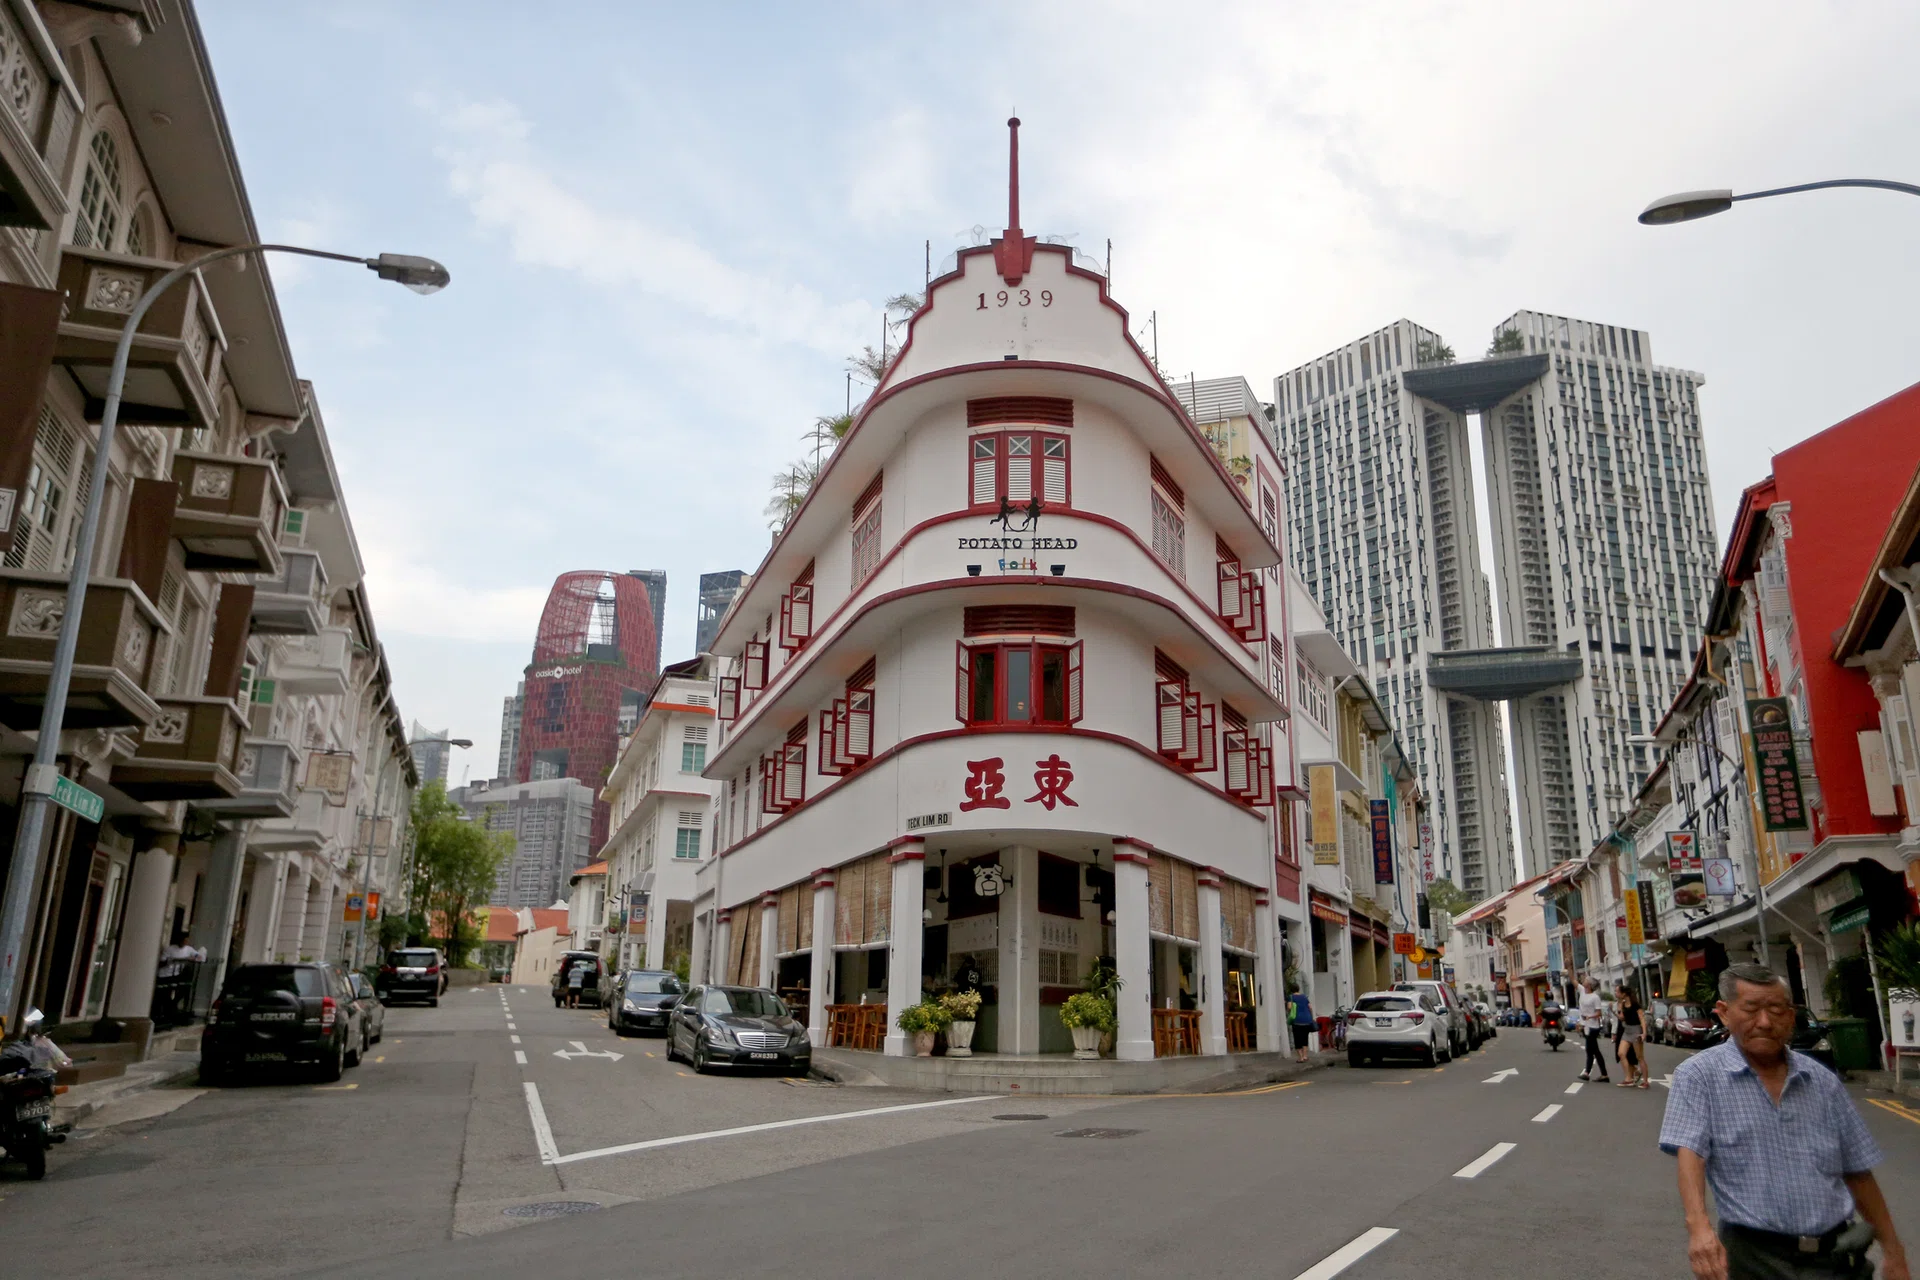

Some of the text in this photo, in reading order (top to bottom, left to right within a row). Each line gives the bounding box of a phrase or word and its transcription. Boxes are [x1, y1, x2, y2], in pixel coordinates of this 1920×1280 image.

[976, 289, 1053, 311] 1939
[958, 538, 1078, 550] POTATO HEAD
[535, 665, 582, 678] oasia hotel
[73, 790, 88, 812] Lim
[907, 813, 948, 829] TECK LIM RD
[1422, 836, 1434, 882] 中山會館
[250, 1012, 296, 1021] SUZUKI
